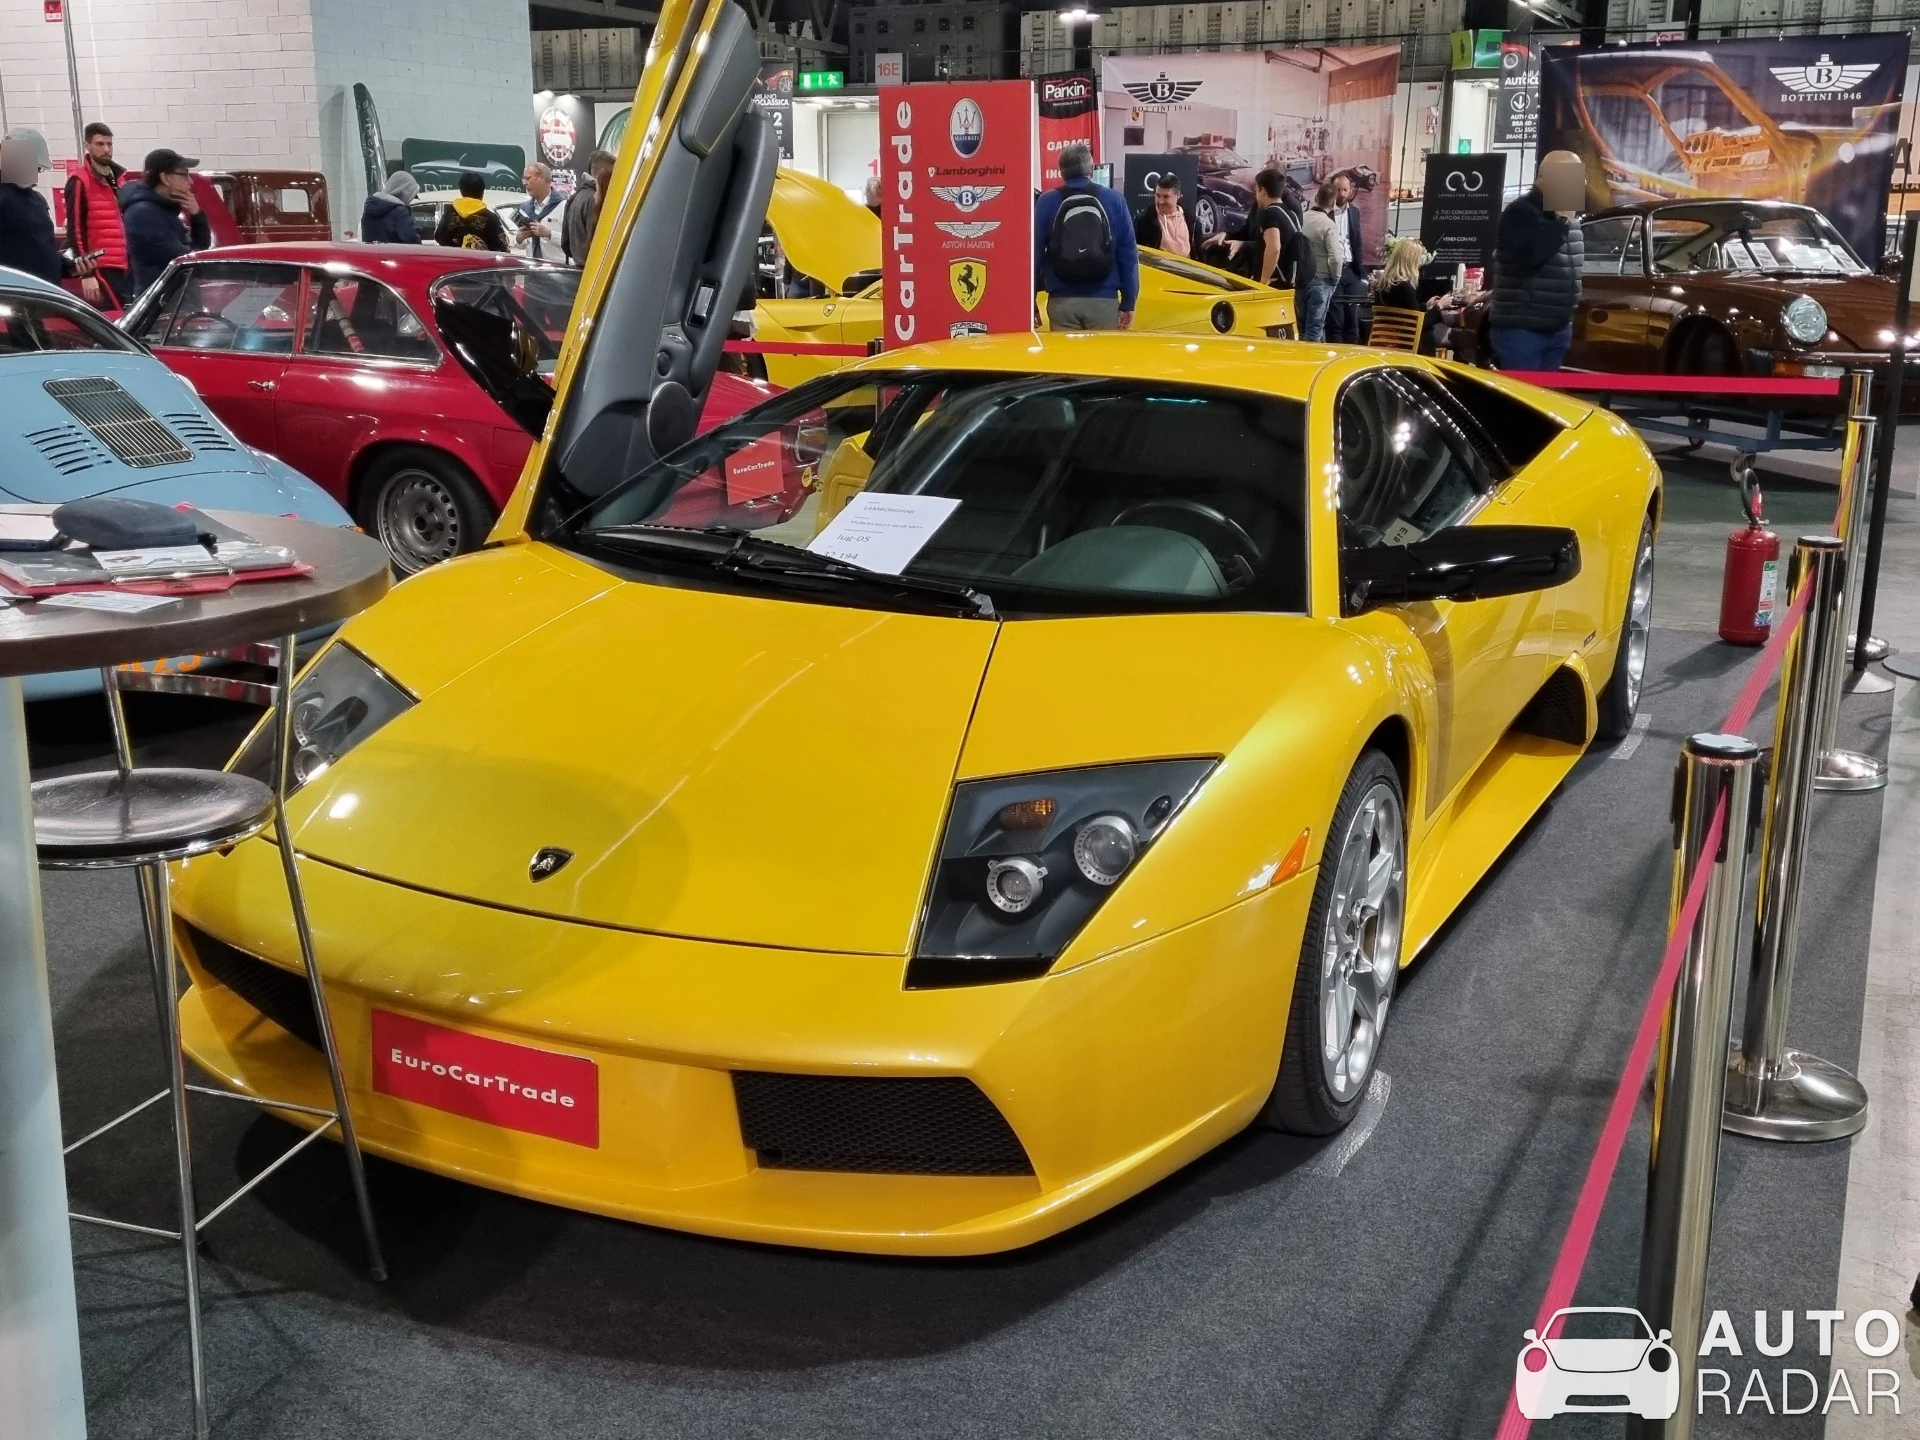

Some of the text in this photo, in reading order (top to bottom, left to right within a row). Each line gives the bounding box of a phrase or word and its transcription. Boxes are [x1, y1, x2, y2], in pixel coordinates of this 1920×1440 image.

[878, 63, 900, 76] 16E
[1780, 92, 1862, 102] BOTTINI 1946
[1132, 105, 1170, 113] BOTTINI
[936, 166, 1006, 177] Lamborghini
[891, 101, 915, 342] CarTrade
[942, 240, 995, 249] ASTON MARTIN
[950, 322, 986, 331] PORSCHE
[732, 460, 775, 475] EuroCarTrade
[863, 506, 915, 514] LAMBORGHINI
[836, 533, 872, 542] lug-05
[391, 1047, 576, 1108] EuroCarTrade
